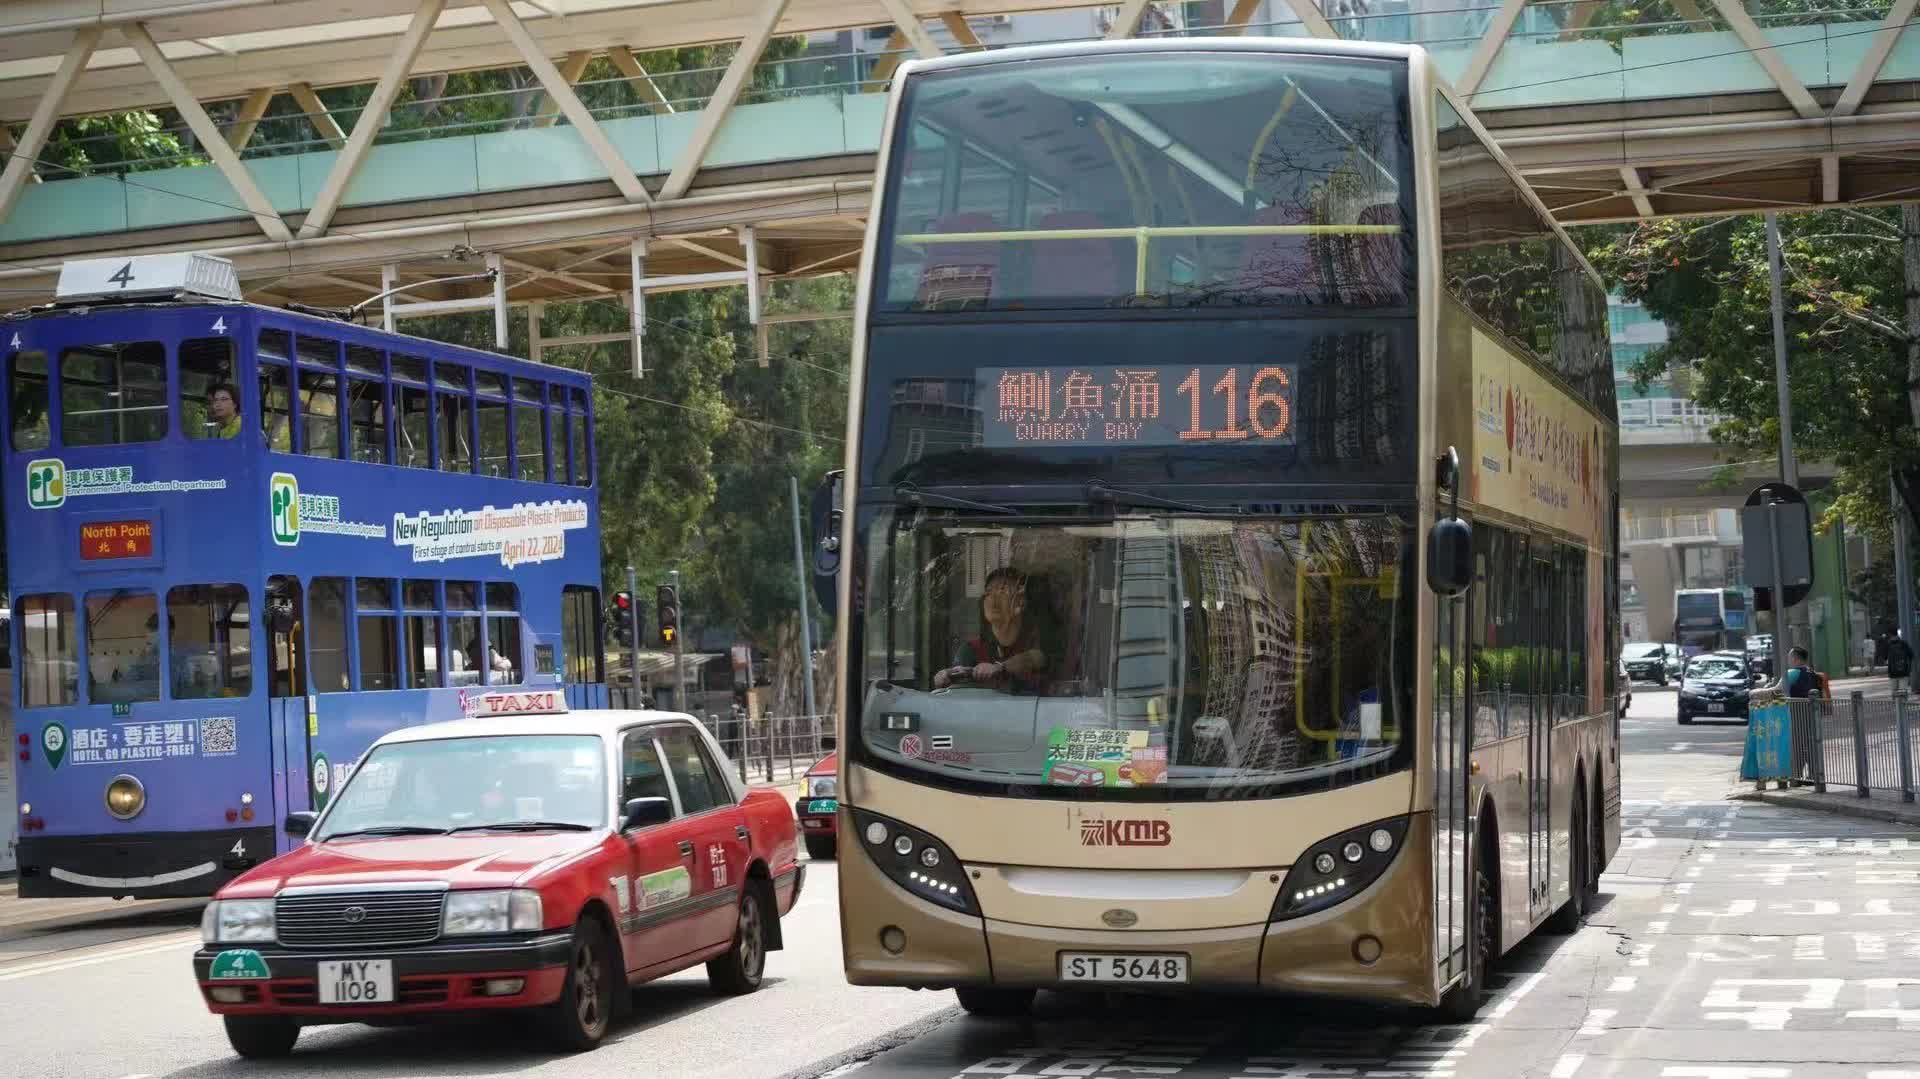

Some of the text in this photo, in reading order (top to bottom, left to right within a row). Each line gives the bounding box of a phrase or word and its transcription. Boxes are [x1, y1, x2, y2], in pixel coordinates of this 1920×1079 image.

[107, 261, 135, 288] 4
[211, 316, 227, 334] 4
[10, 332, 21, 350] 4
[997, 369, 1160, 422] 鰂魚涌
[1177, 367, 1289, 440] 116
[1015, 422, 1142, 440] QUARRY BAY
[67, 469, 131, 485] 環境保護署
[67, 479, 225, 495] Environmental Protection Department
[82, 523, 151, 539] North Point
[396, 519, 419, 539] New
[420, 515, 472, 541] Regulation
[485, 510, 526, 533] Disposable
[527, 508, 552, 527] Plastic
[554, 505, 584, 524] Products
[98, 540, 137, 553] 北角
[415, 545, 430, 558] First
[430, 544, 448, 559] stage
[455, 540, 477, 555] control
[477, 539, 494, 552] starts
[504, 538, 525, 563] April
[543, 535, 564, 555] 2024
[486, 693, 552, 712] TAXI
[105, 748, 119, 761] GO
[121, 744, 194, 760] PLASTIC-FREE!
[1106, 819, 1172, 846] KMB
[231, 838, 246, 858] 4
[231, 956, 245, 969] 4
[341, 961, 369, 982] MY
[1071, 957, 1179, 980] ST 5648
[335, 980, 378, 1001] 1108
